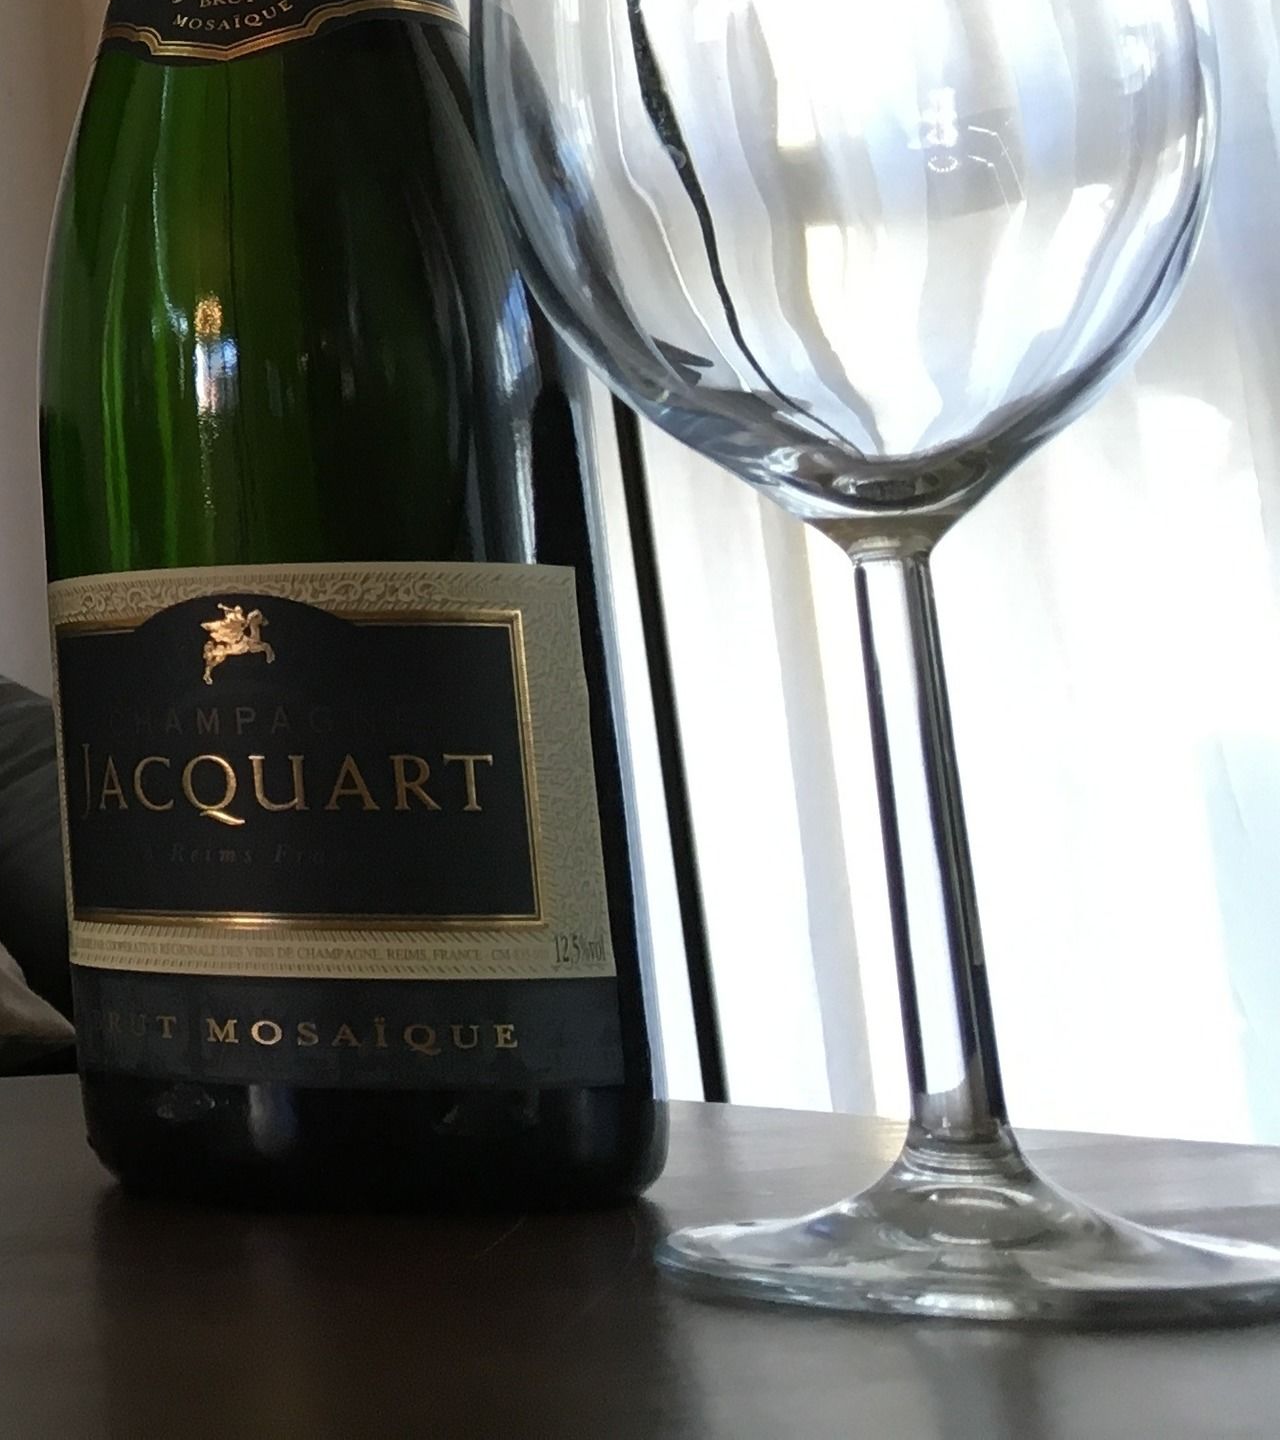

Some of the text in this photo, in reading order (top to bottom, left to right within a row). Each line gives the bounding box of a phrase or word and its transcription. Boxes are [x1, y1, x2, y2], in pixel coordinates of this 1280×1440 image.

[172, 0, 294, 31] MOSAÏQUE
[80, 742, 494, 827] JACQUART
[92, 1008, 520, 1057] RUT MOSAÏQUE
